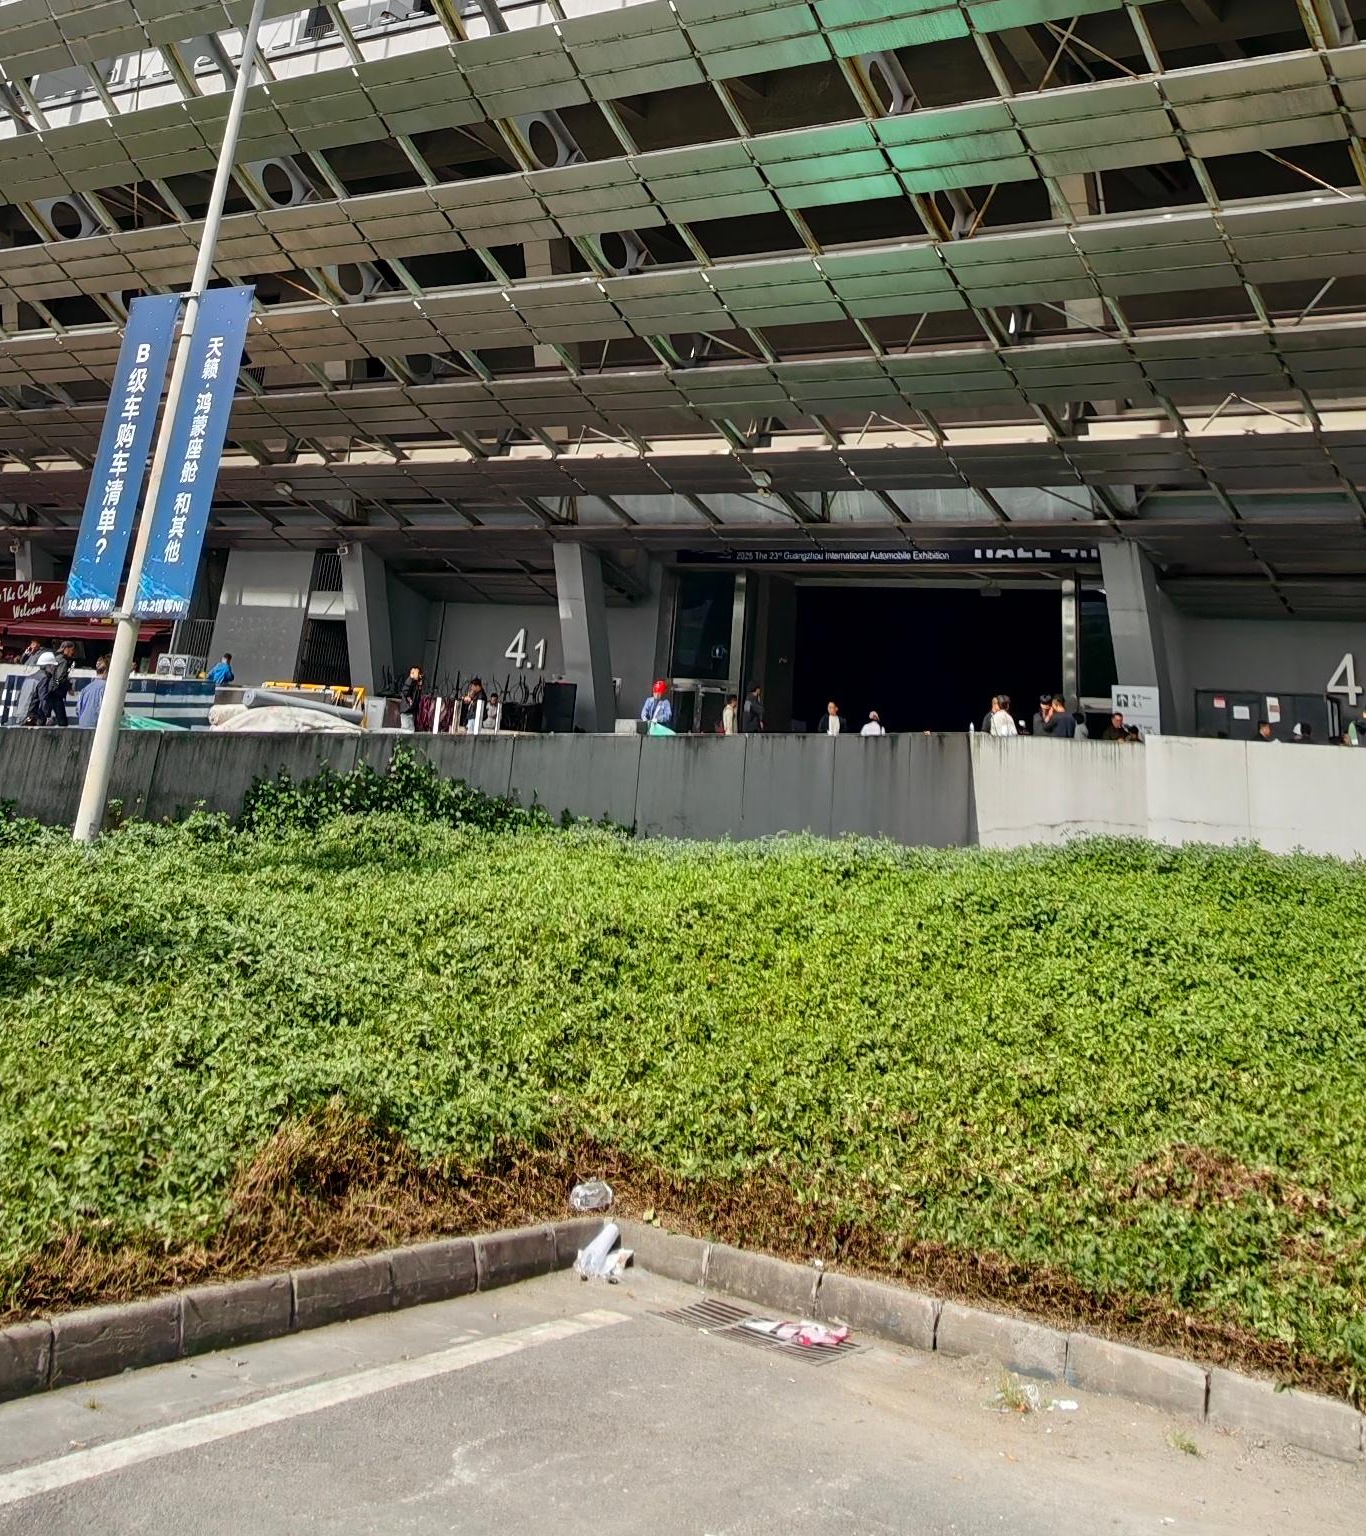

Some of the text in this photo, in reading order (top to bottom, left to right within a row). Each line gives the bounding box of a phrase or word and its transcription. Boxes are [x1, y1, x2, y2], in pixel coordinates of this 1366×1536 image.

[163, 492, 192, 564] 和其他
[784, 551, 824, 562] Guangzhou
[825, 551, 869, 560] International
[870, 550, 911, 560] Automobile
[913, 550, 950, 561] Exhibition
[2, 587, 16, 603] The
[17, 581, 43, 603] Coffee
[12, 602, 47, 620] Welcome
[504, 627, 545, 670] 4.1
